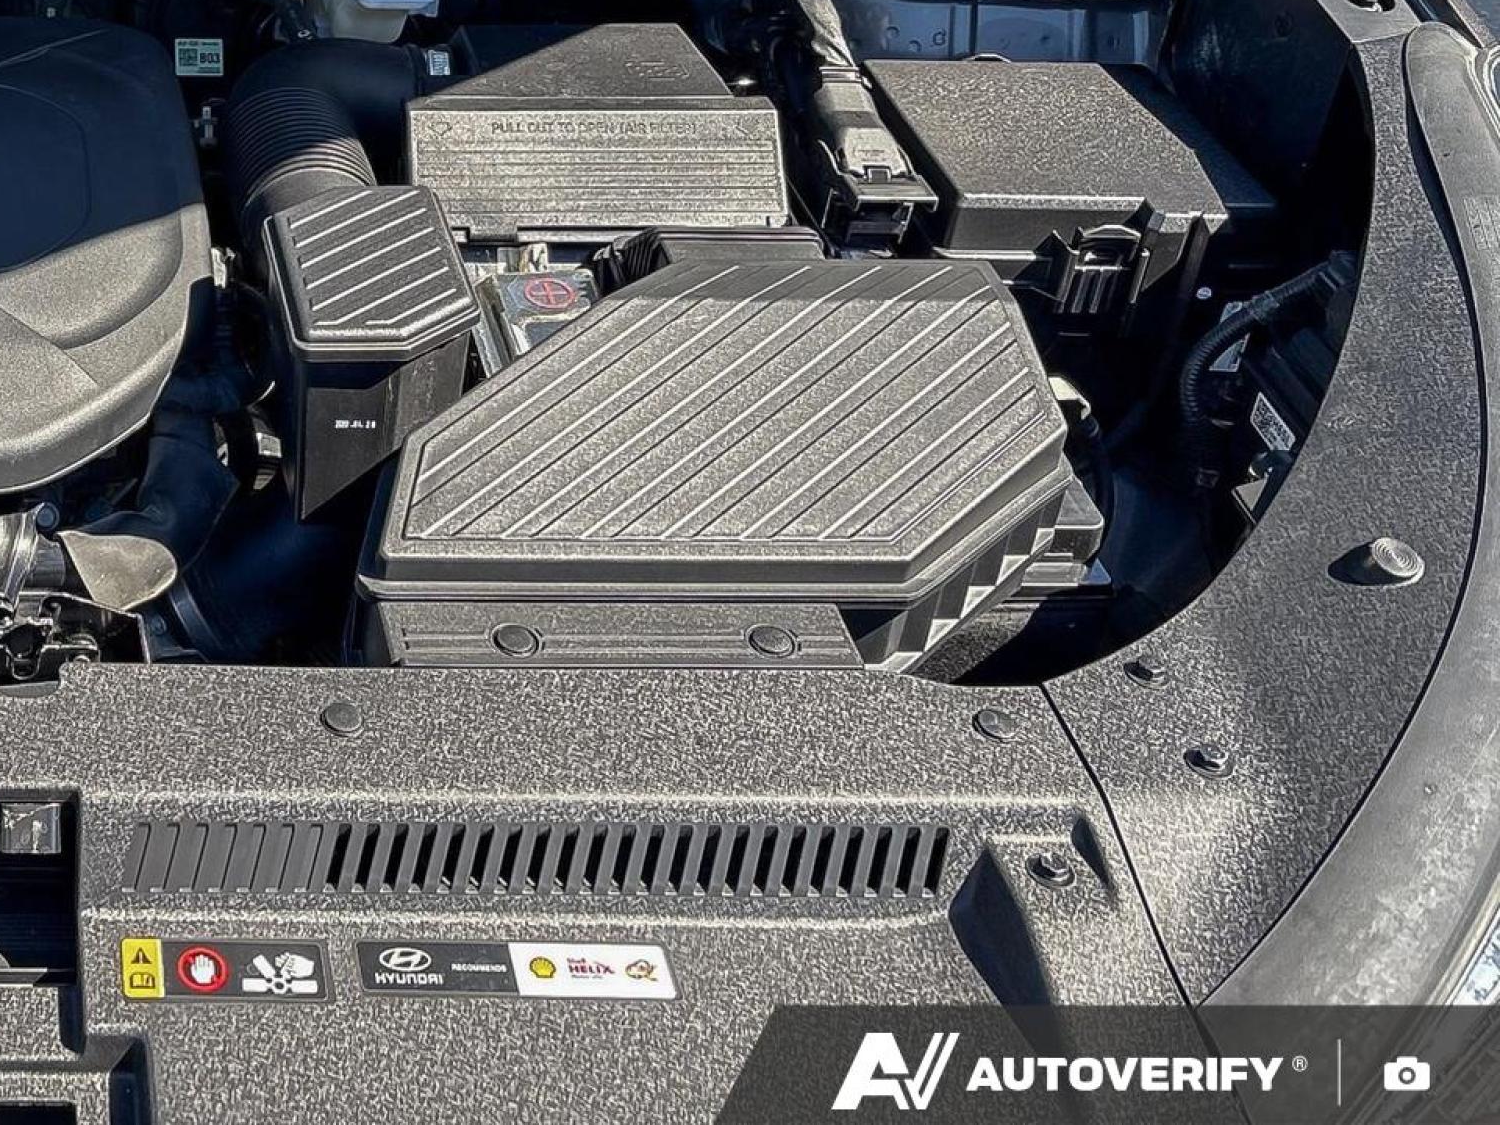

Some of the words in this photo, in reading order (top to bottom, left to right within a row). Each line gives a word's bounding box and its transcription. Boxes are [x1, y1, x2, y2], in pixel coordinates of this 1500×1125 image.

[491, 121, 524, 135] PULL
[527, 121, 553, 135] OUT
[556, 121, 575, 135] TO
[577, 121, 616, 135] OPEN
[451, 963, 507, 973] RECOMMENDS
[568, 961, 616, 974] HELIX
[375, 972, 444, 985] HYUNDAI
